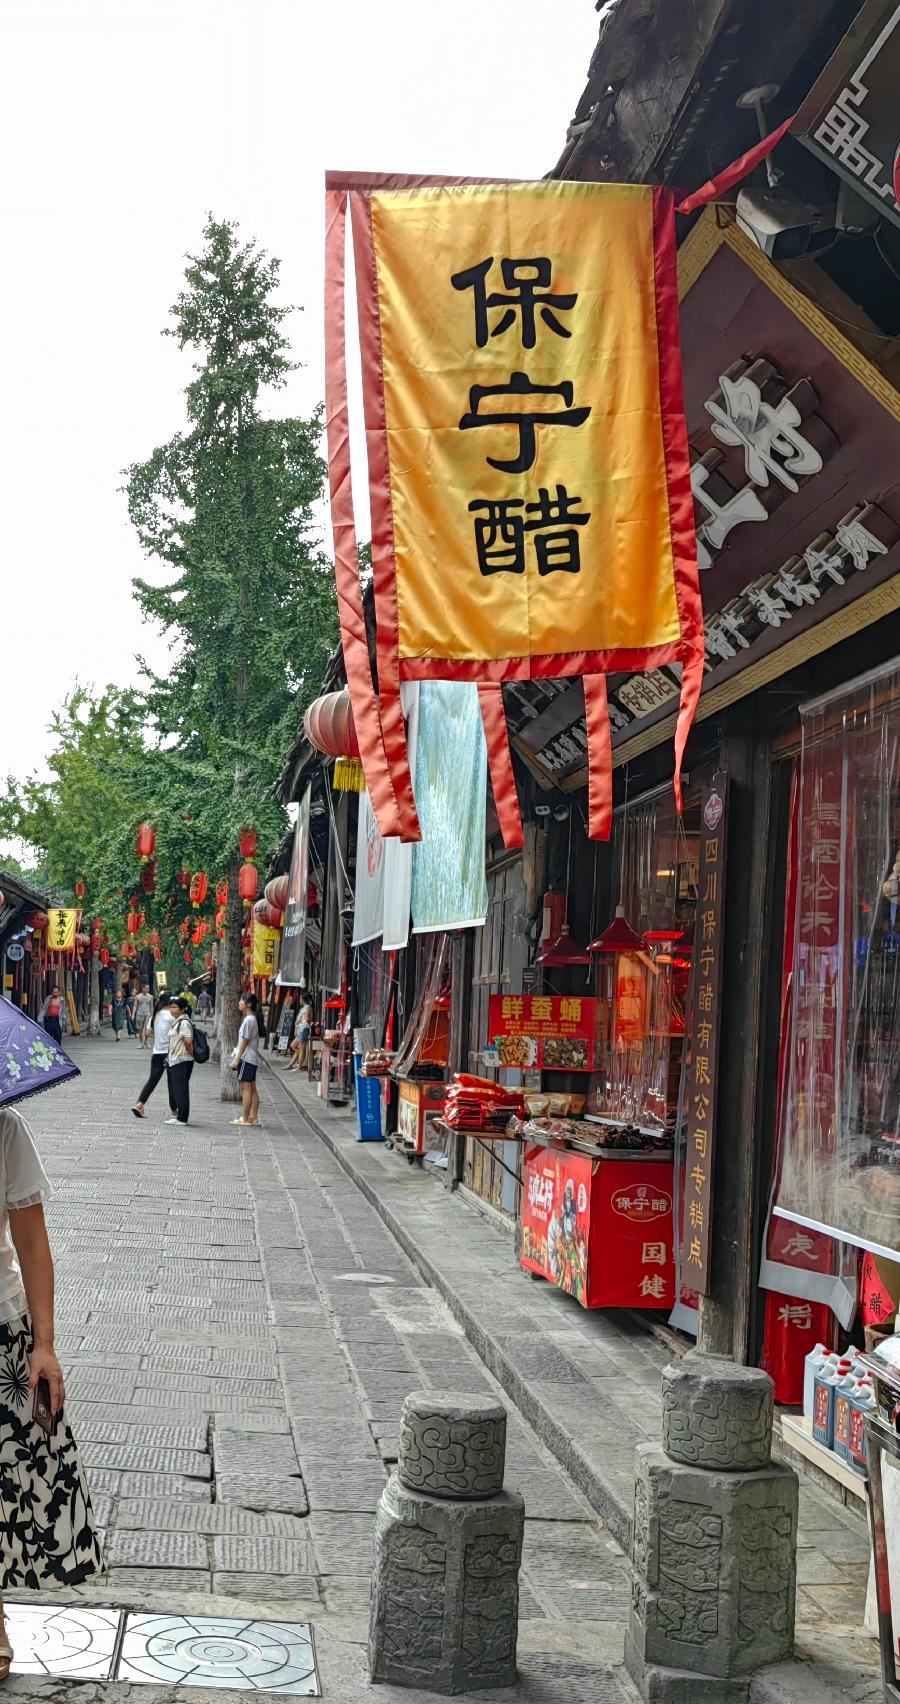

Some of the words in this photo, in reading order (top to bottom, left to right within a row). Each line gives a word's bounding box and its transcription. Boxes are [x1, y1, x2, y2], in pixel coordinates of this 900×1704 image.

[451, 256, 592, 576] 保宁醋
[690, 373, 823, 568] 上将
[502, 996, 582, 1021] 鲜蚕蛹
[687, 837, 719, 1269] 四川保宁醋有限公司专销点
[615, 1197, 669, 1212] 保宁醋
